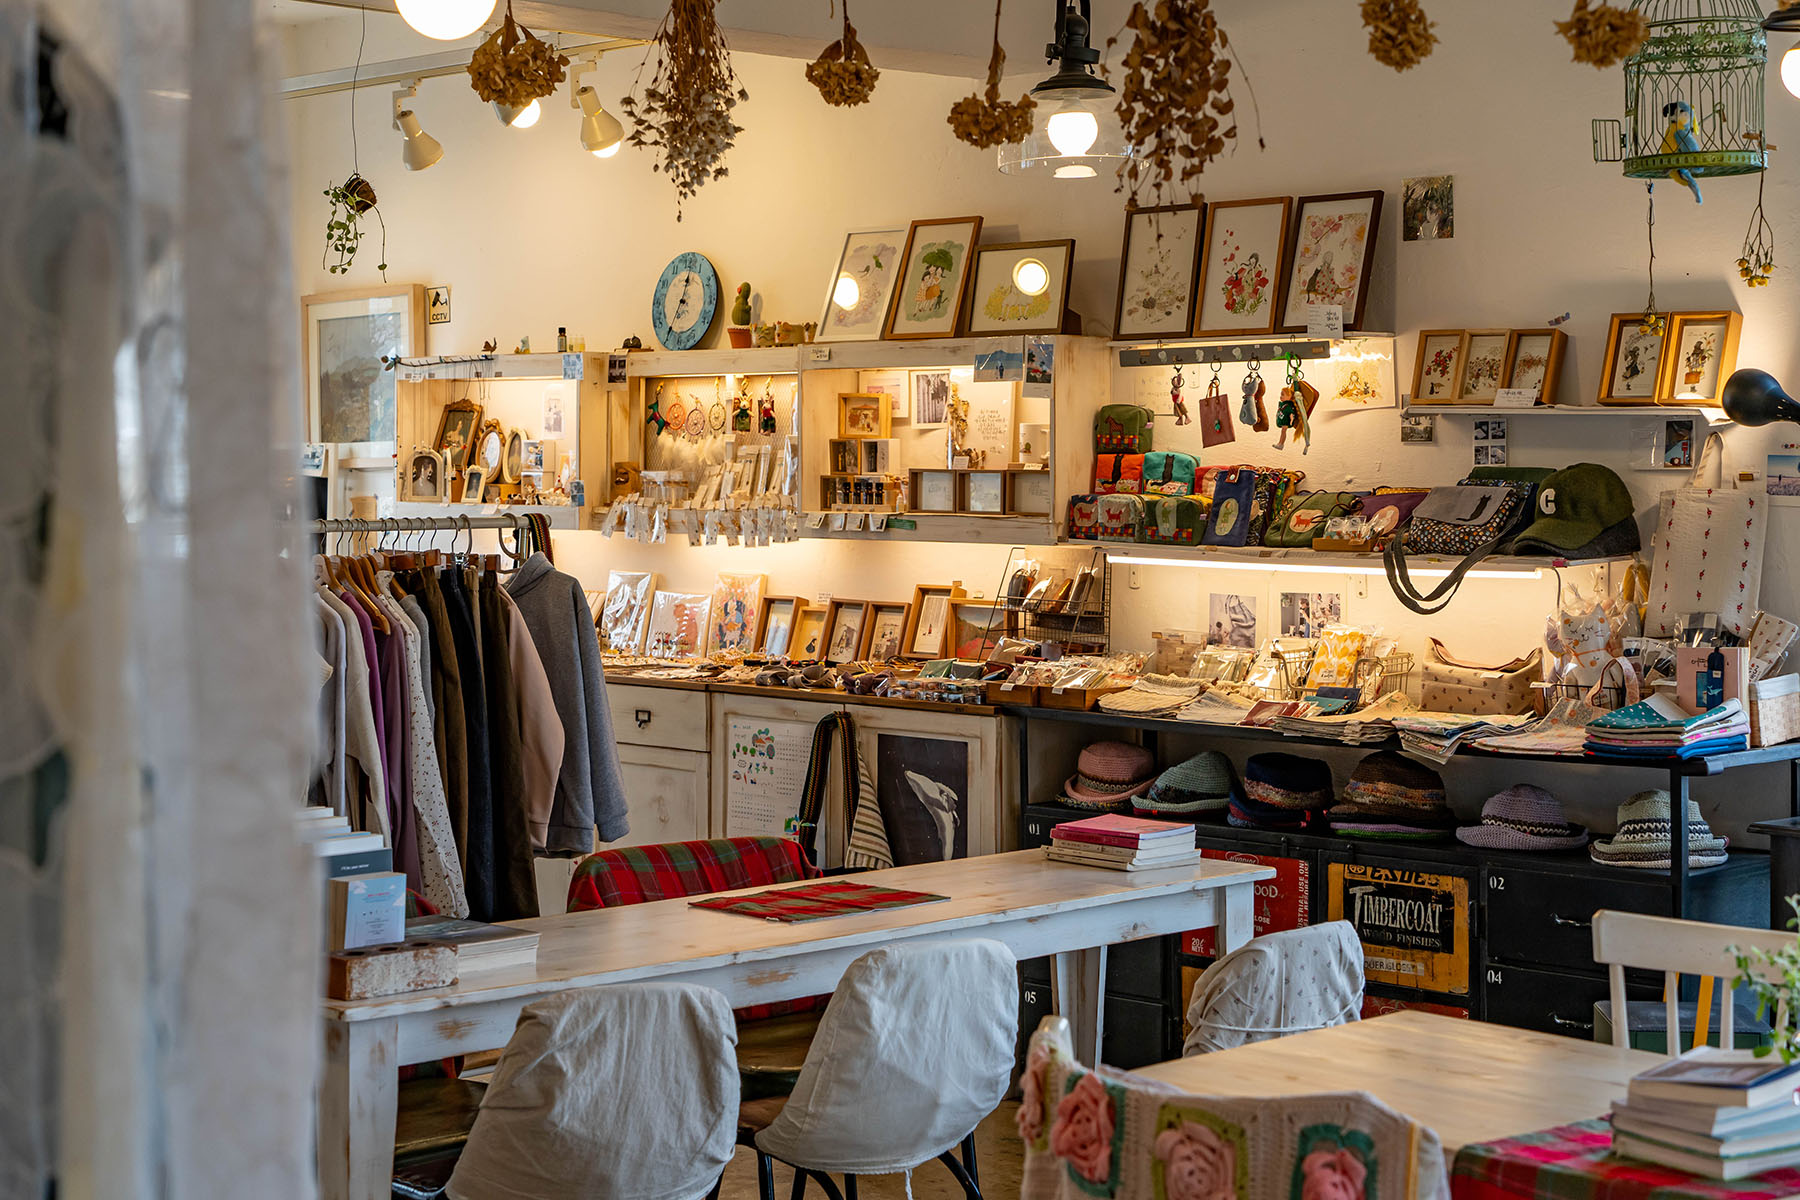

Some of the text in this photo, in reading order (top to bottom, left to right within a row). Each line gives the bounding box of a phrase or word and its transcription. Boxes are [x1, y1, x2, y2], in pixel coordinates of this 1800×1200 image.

[432, 313, 448, 321] CCTV
[1540, 488, 1556, 514] C
[1029, 823, 1040, 835] 01
[1489, 876, 1505, 890] 02
[1349, 886, 1442, 933] TIMBERCOAT
[1396, 933, 1441, 948] FINISHES
[1487, 970, 1502, 984] 04
[1024, 990, 1037, 1004] 05
